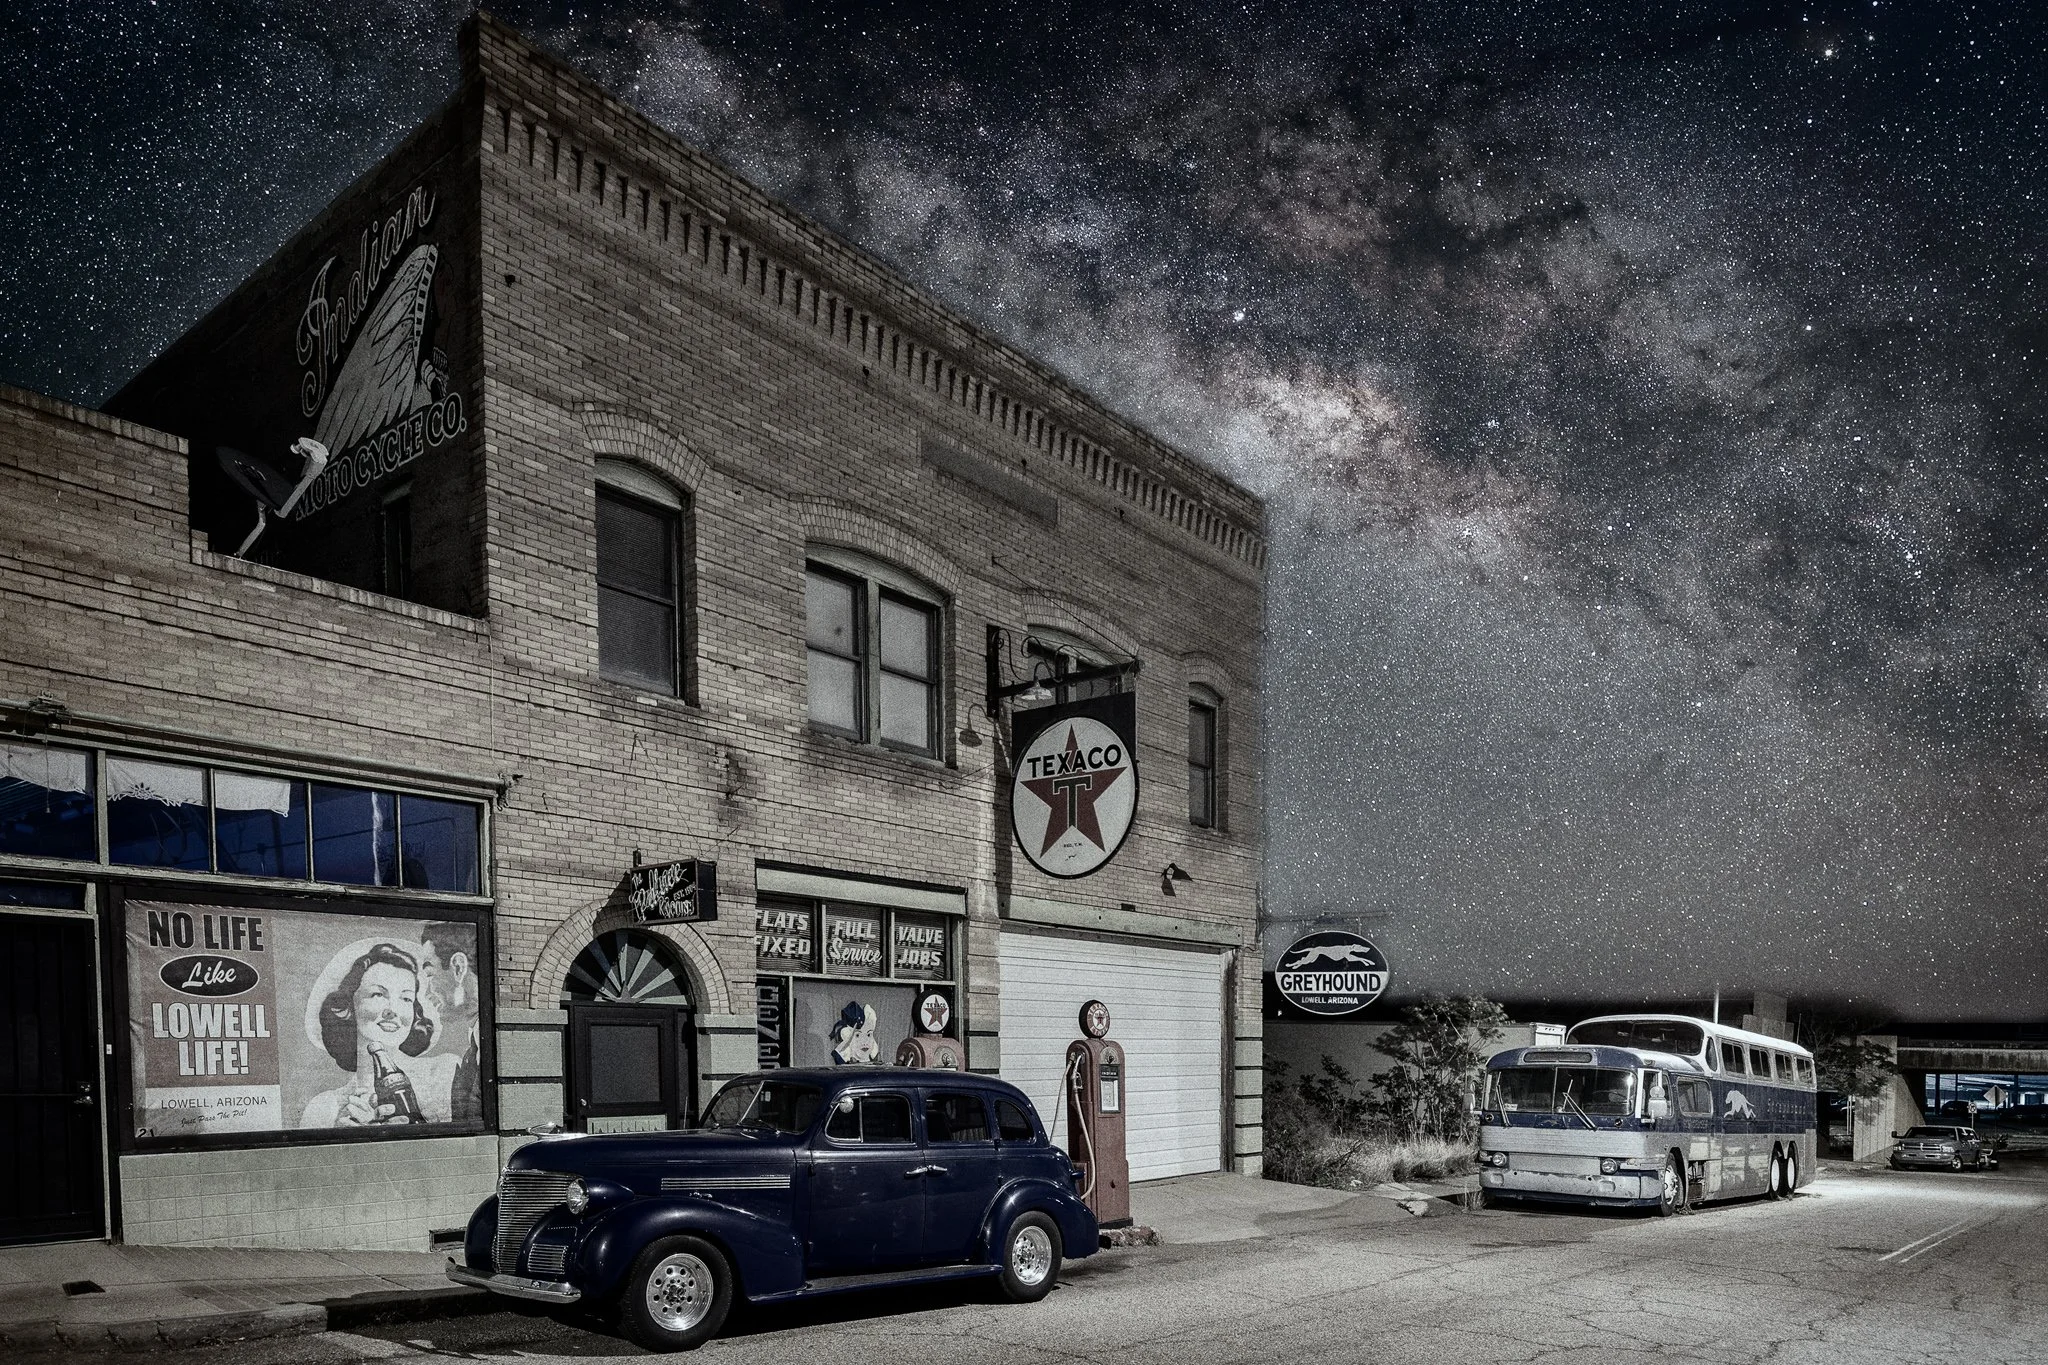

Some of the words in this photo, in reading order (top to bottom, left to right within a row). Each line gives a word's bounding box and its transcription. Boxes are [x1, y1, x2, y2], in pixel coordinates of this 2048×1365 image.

[296, 185, 437, 417] Indian
[426, 392, 467, 447] CO.
[1027, 744, 1122, 778] TEXACO
[1053, 775, 1092, 828] T
[755, 909, 810, 930] FLATS
[834, 920, 876, 939] FULL
[147, 911, 195, 949] NO
[204, 913, 264, 952] LIFE
[898, 926, 943, 945] VALVE
[754, 935, 811, 955] FIXED
[830, 938, 883, 963] Service
[897, 949, 943, 967] JOBS
[181, 961, 237, 990] Like
[1280, 973, 1381, 992] GREYHOUND
[1302, 996, 1326, 1004] LOWELL
[1328, 997, 1359, 1005] ARIZONA
[151, 1003, 271, 1039] LOWELL
[178, 1041, 249, 1076] LIFE!
[161, 1098, 213, 1110] LOWELL,
[217, 1096, 267, 1107] ARIZONA
[181, 1118, 196, 1128] Just
[198, 1115, 216, 1123] Pass
[217, 1112, 230, 1120] The
[232, 1109, 248, 1118] Pit!
